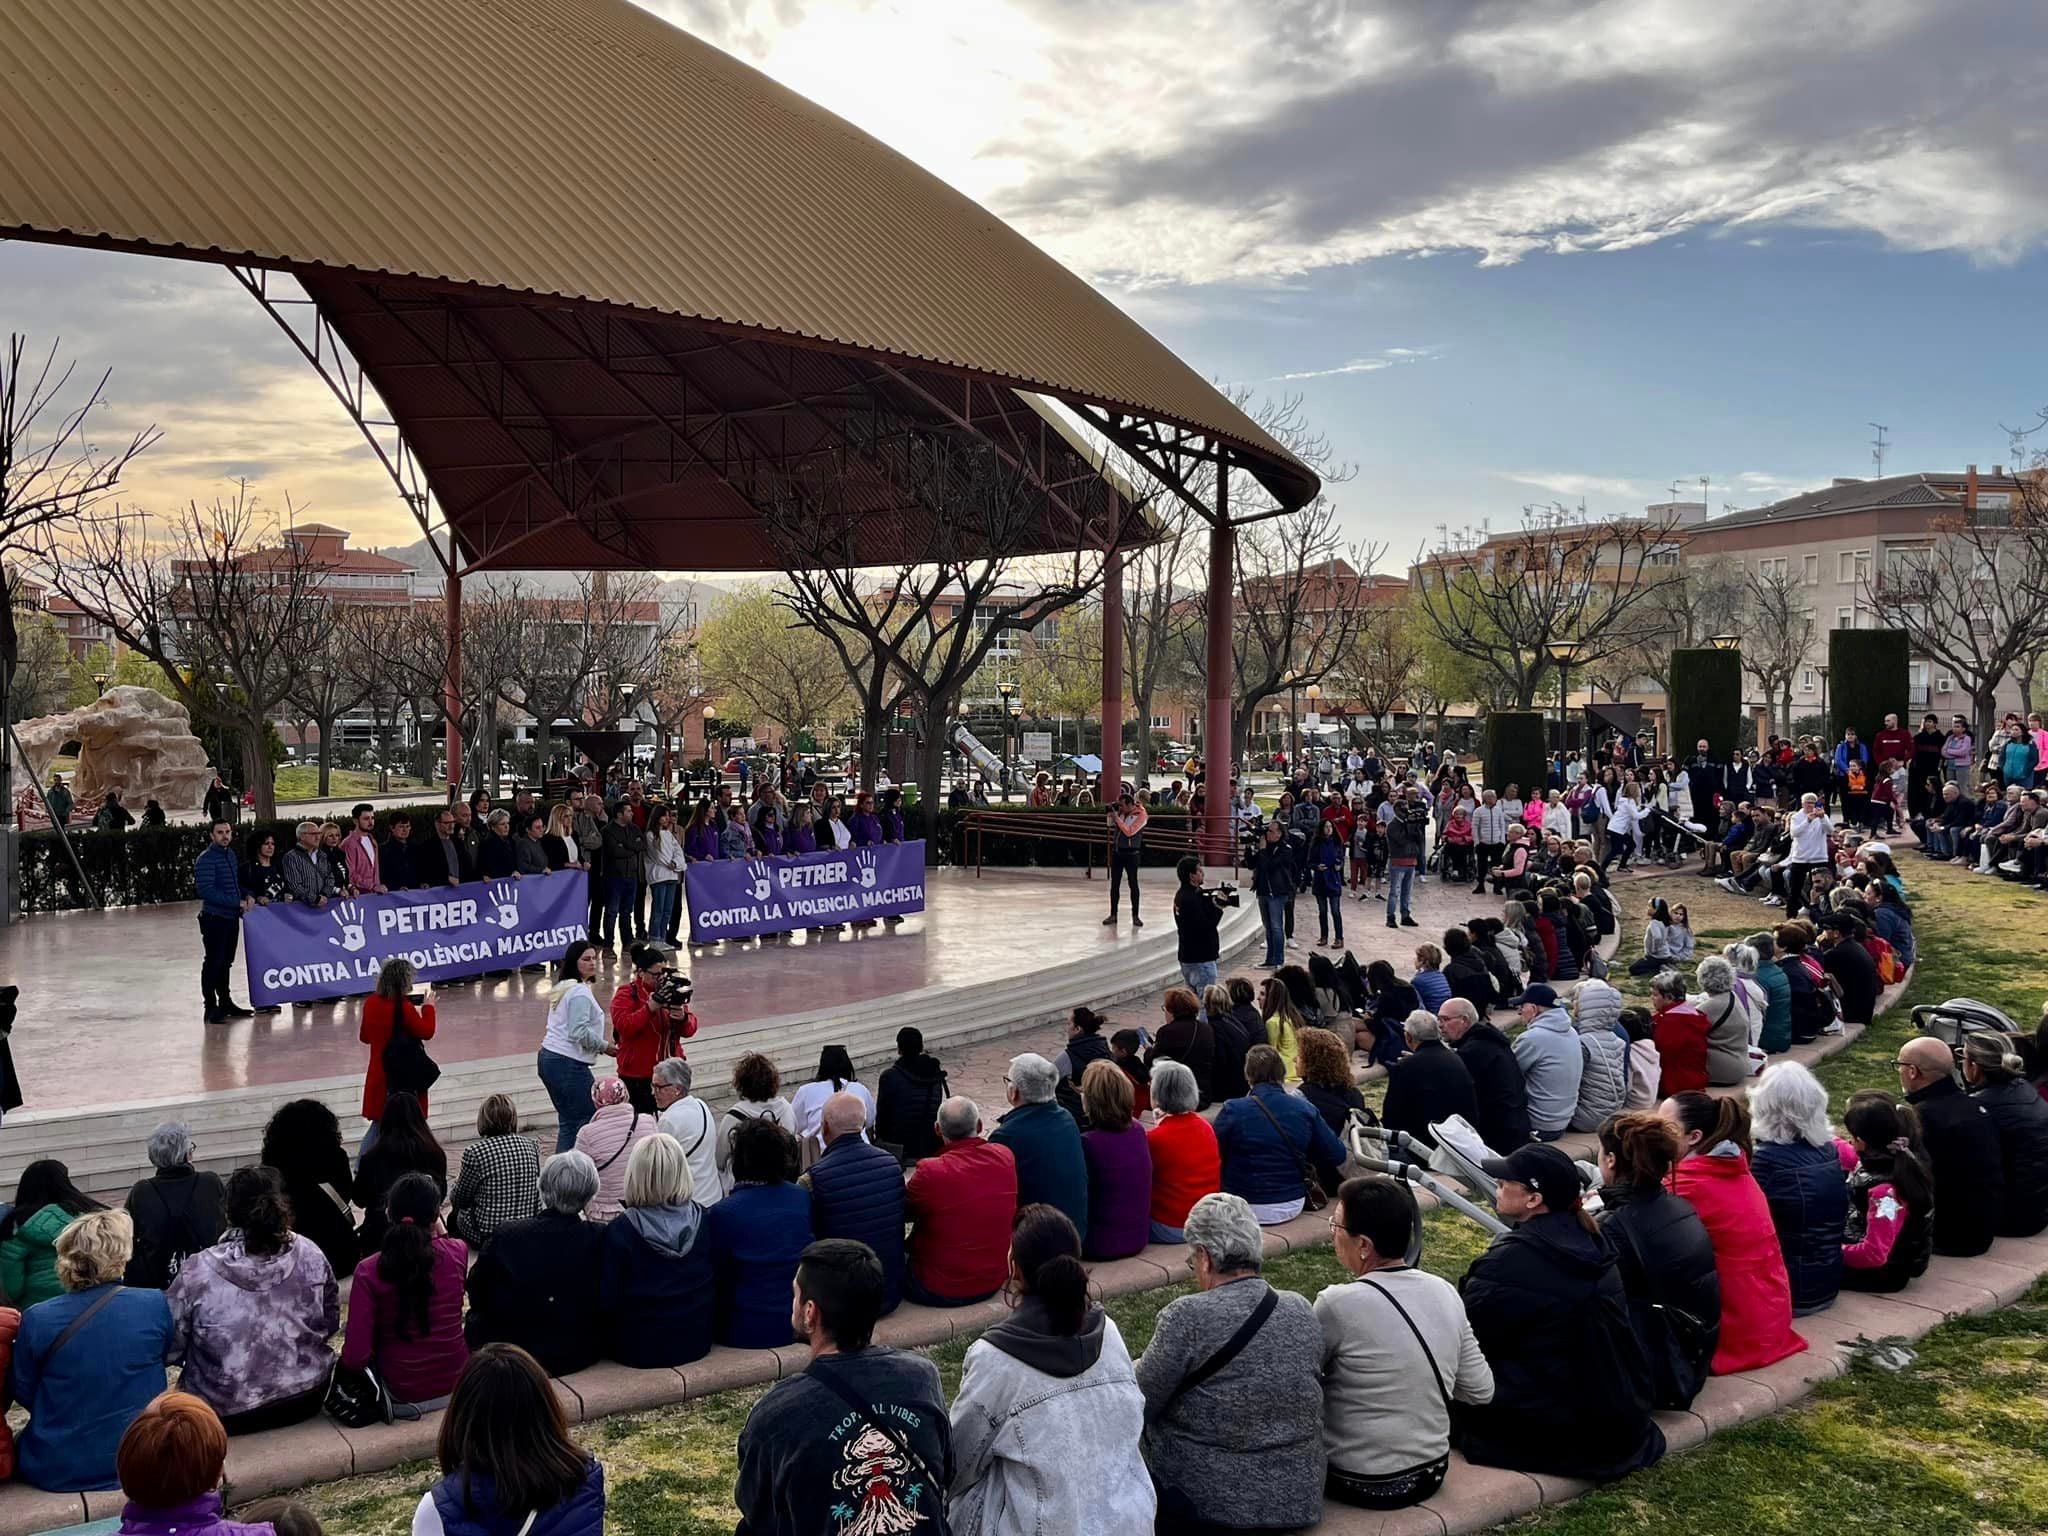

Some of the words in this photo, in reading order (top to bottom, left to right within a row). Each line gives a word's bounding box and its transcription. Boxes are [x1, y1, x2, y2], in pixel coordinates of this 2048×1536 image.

[778, 861, 848, 889] PETRER
[377, 899, 479, 936] PETRER
[698, 905, 760, 928] CONTRA
[763, 903, 783, 921] LA
[787, 893, 860, 917] VIOLENCIA
[861, 885, 924, 908] MACHISTA
[263, 962, 351, 989] CONTRA
[355, 956, 382, 978] LA
[497, 923, 589, 956] MASCLISTA
[827, 1403, 886, 1441] TROPAL
[890, 1403, 921, 1429] VIBES
